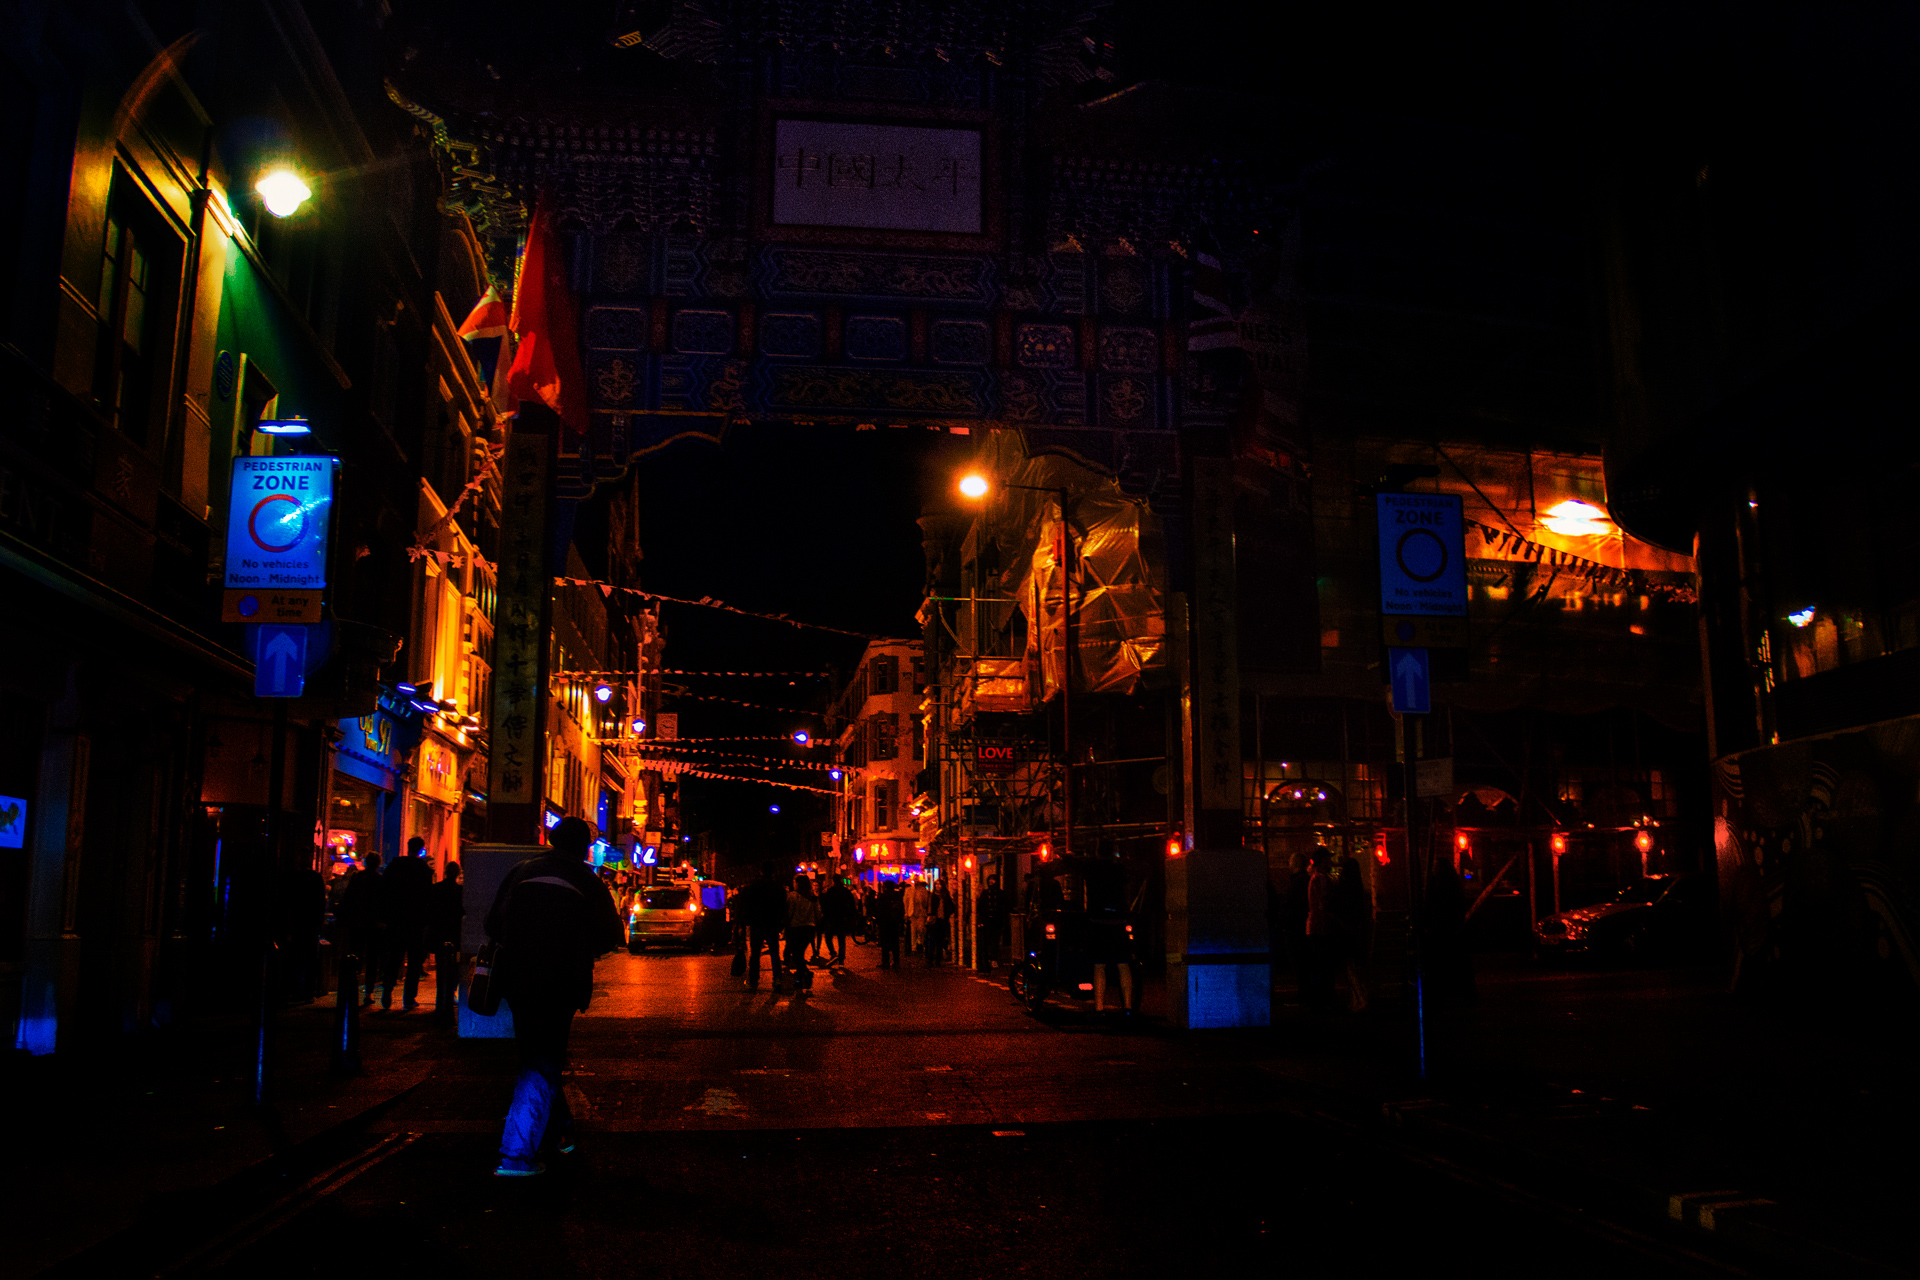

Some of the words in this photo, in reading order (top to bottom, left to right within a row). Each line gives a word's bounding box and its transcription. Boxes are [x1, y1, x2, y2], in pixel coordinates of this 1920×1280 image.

[243, 462, 323, 472] PEDESTRIAN
[252, 475, 310, 490] ZONE
[1385, 496, 1454, 508] PEDESTRIAN
[1395, 510, 1444, 525] ZONE
[242, 559, 259, 569] No
[263, 559, 309, 569] vehicles
[229, 573, 260, 584] Noon
[269, 573, 320, 586] Midnight
[1395, 587, 1410, 597] No
[1413, 588, 1453, 598] vehicles
[271, 595, 286, 605] At
[289, 597, 309, 608] any
[1385, 601, 1412, 610] Noon
[1420, 602, 1463, 612] Midnight
[277, 608, 302, 618] time
[978, 746, 1014, 759] LOVE
